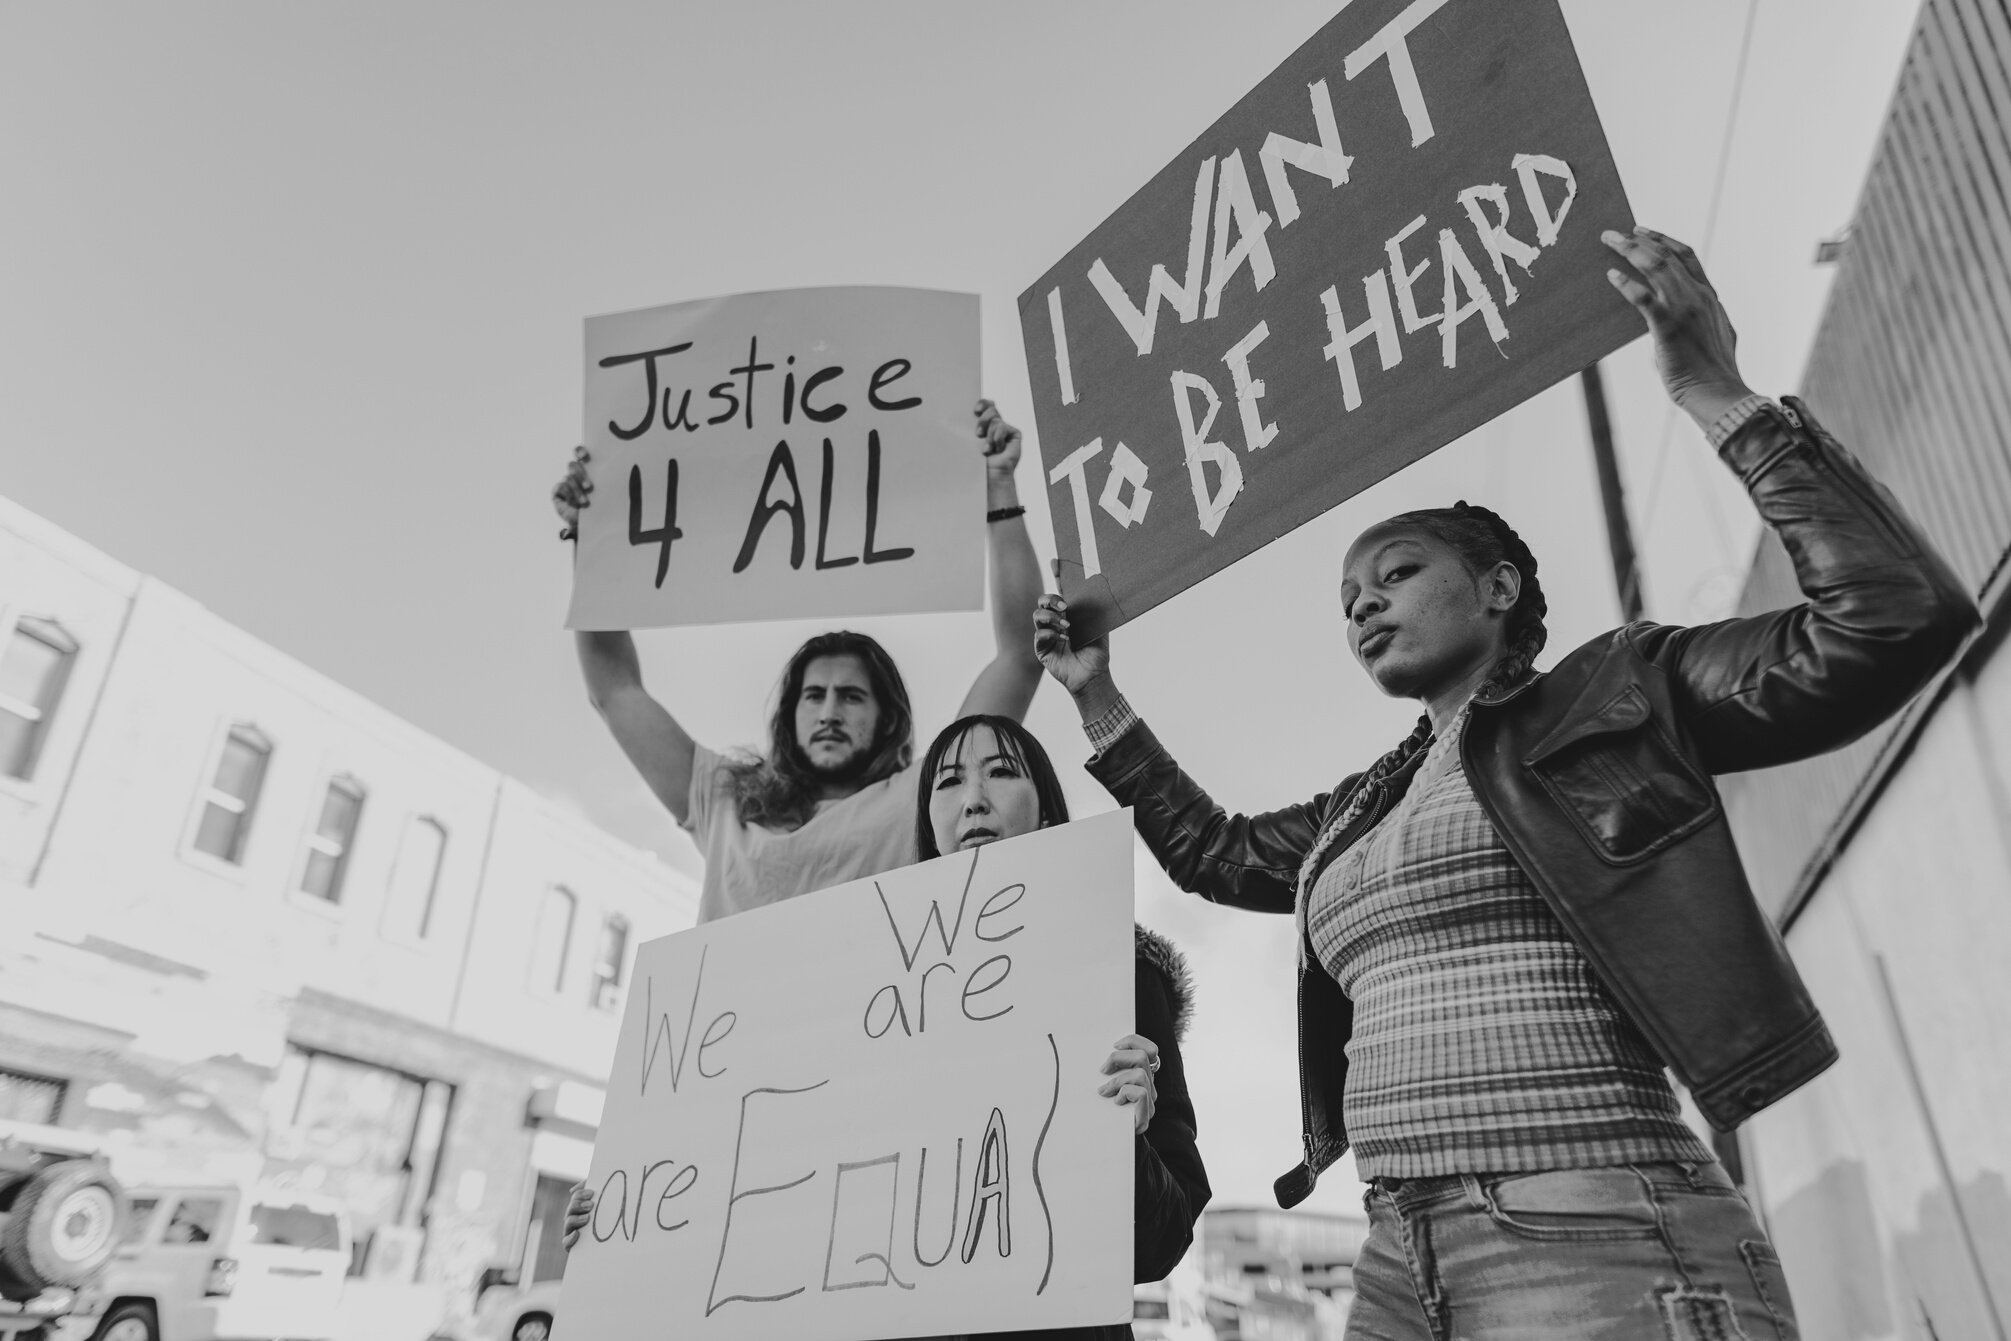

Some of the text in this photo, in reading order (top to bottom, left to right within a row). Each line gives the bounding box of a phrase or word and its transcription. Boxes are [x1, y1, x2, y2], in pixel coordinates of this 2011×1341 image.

[1048, 0, 1449, 406] I WANT
[598, 335, 922, 441] Justice
[1050, 152, 1577, 579] TO BE HEARD
[629, 429, 915, 589] 4 ALL
[874, 846, 1026, 972] We
[641, 944, 736, 1097] We
[864, 954, 1014, 1039] are
[592, 1159, 698, 1243] are
